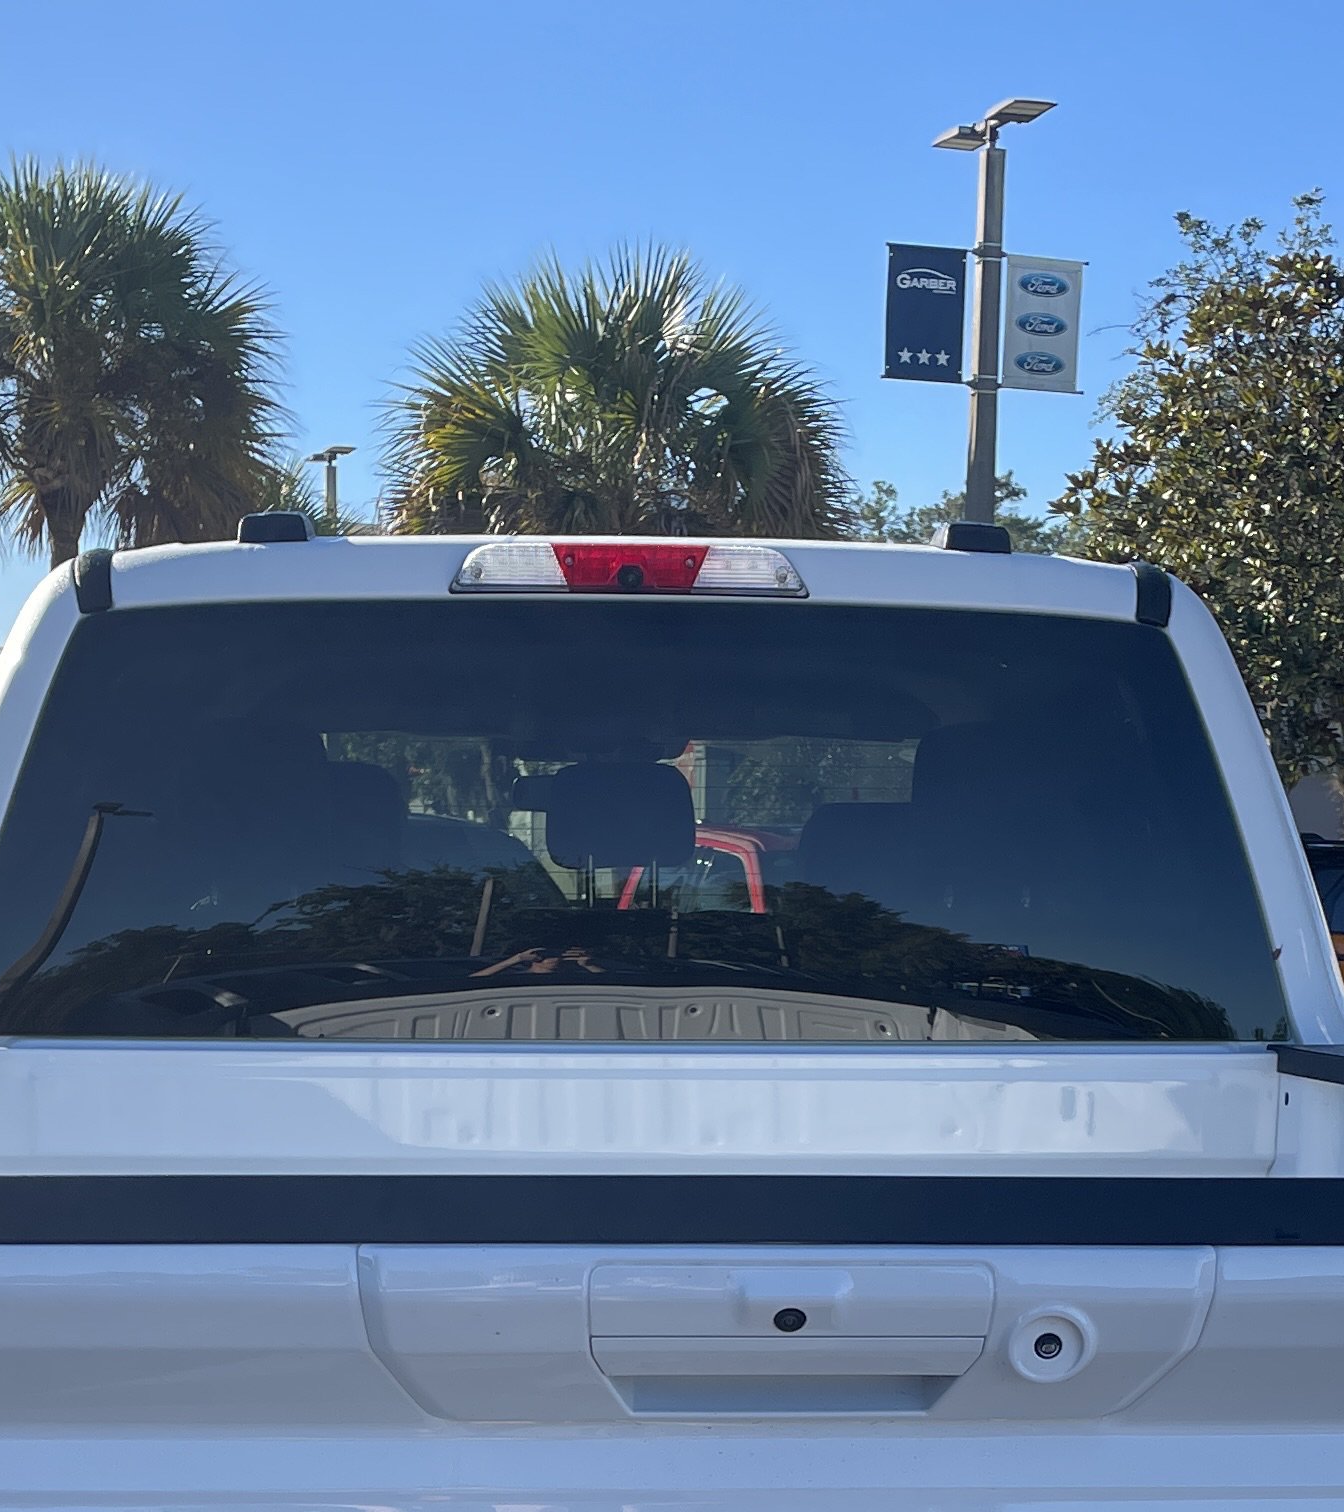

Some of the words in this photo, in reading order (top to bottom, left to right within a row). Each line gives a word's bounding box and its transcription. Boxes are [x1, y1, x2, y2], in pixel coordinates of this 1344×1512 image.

[896, 273, 956, 291] GARBER
[1027, 277, 1059, 295] Ford
[1025, 316, 1057, 333] Ford
[1023, 355, 1055, 372] Ford
